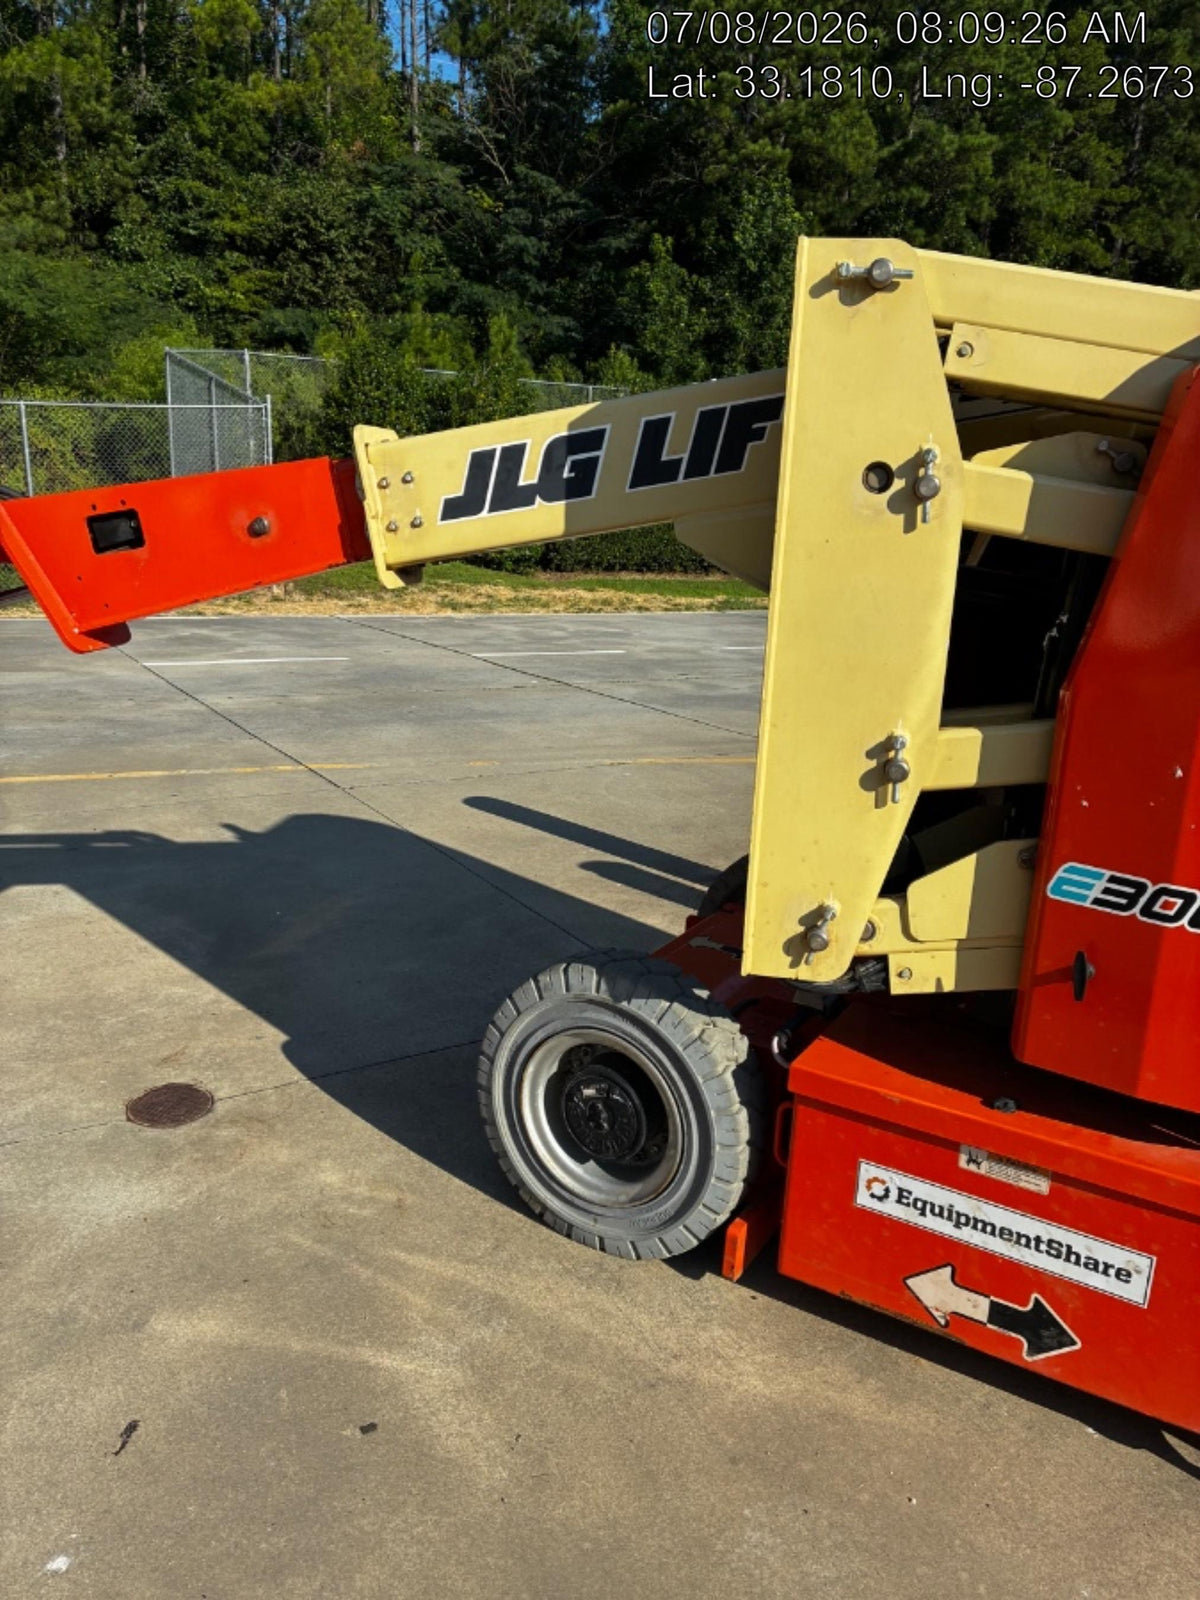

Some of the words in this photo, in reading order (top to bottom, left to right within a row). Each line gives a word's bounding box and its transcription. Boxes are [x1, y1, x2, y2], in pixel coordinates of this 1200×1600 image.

[438, 424, 611, 525] JLG
[1047, 862, 1200, 933] E30
[895, 1186, 1134, 1285] EquipmentShare
